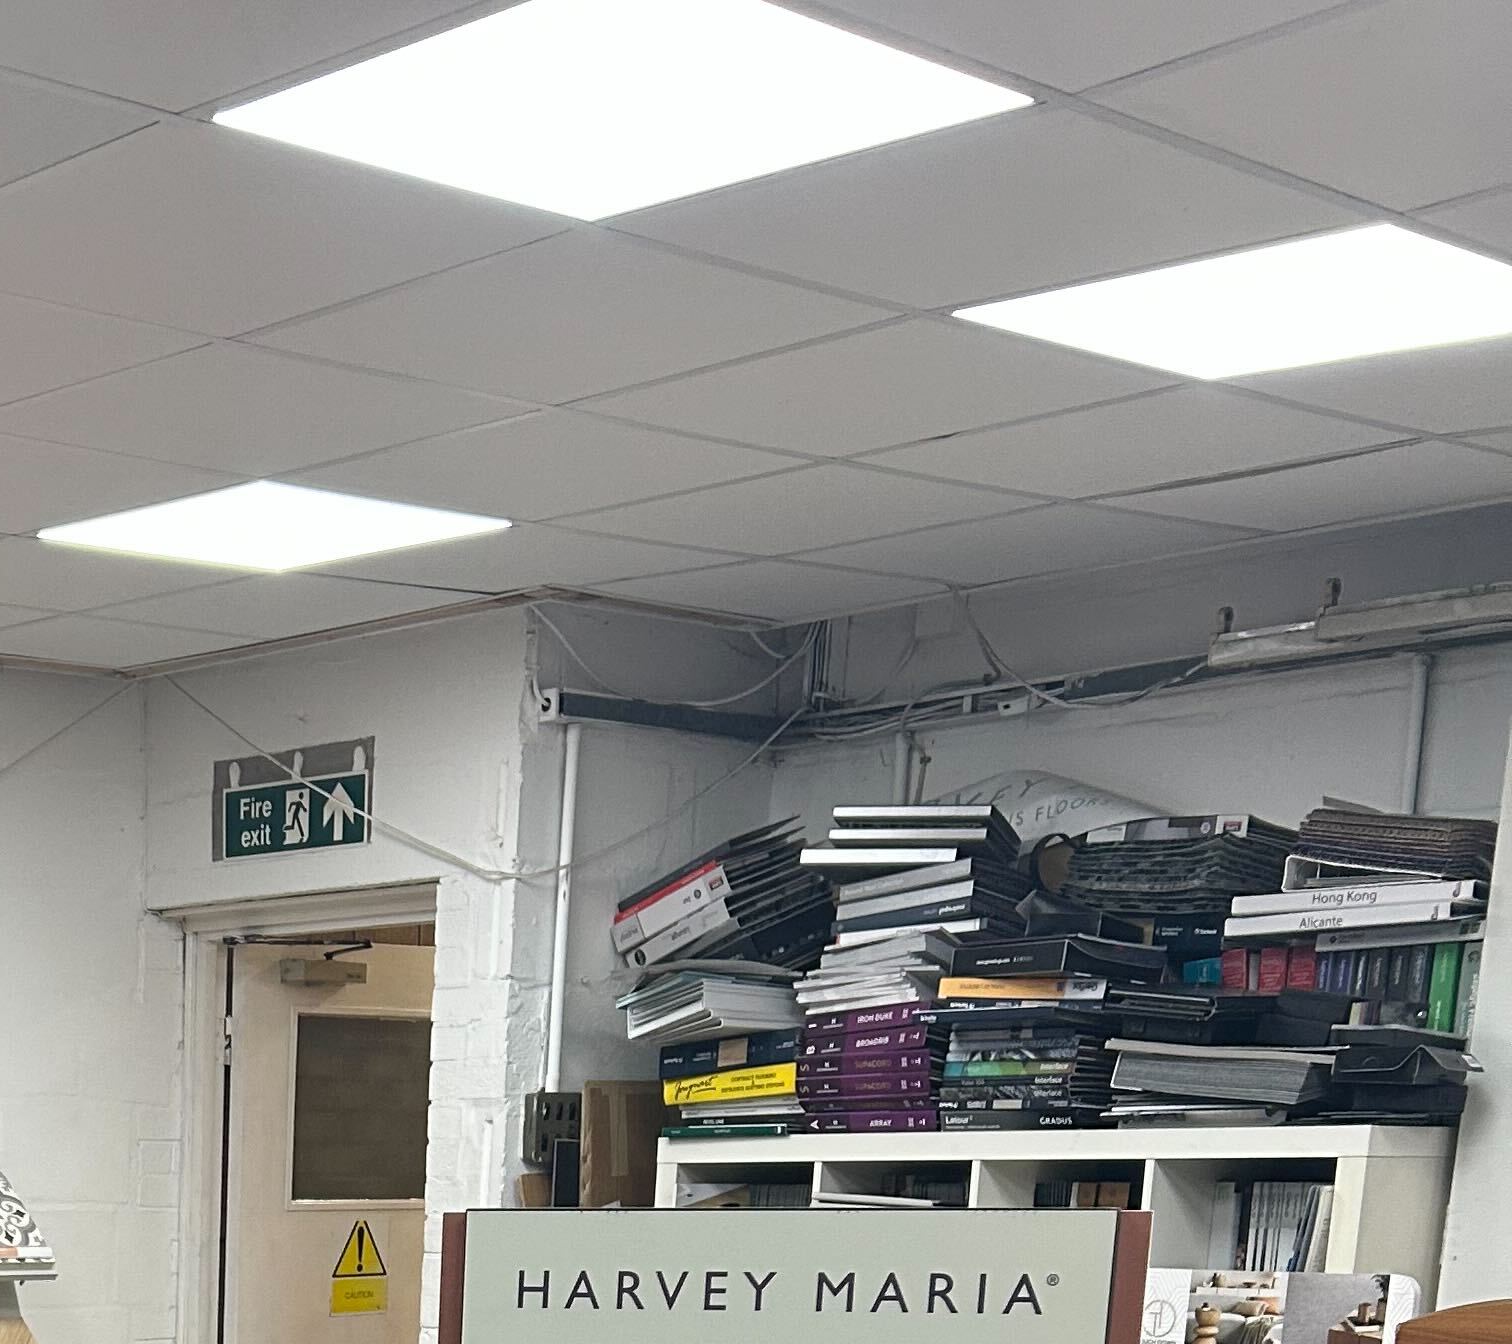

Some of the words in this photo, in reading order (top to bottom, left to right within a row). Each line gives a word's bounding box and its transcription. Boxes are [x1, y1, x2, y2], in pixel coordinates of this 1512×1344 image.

[240, 797, 273, 820] Fire
[241, 824, 272, 848] exit
[1312, 890, 1344, 908] Hong
[1347, 888, 1378, 904] Kong
[1298, 914, 1344, 929] Alicante
[1039, 1116, 1073, 1126] GRADUS
[344, 1290, 374, 1300] CAUTION
[517, 1269, 778, 1311] HARVEY
